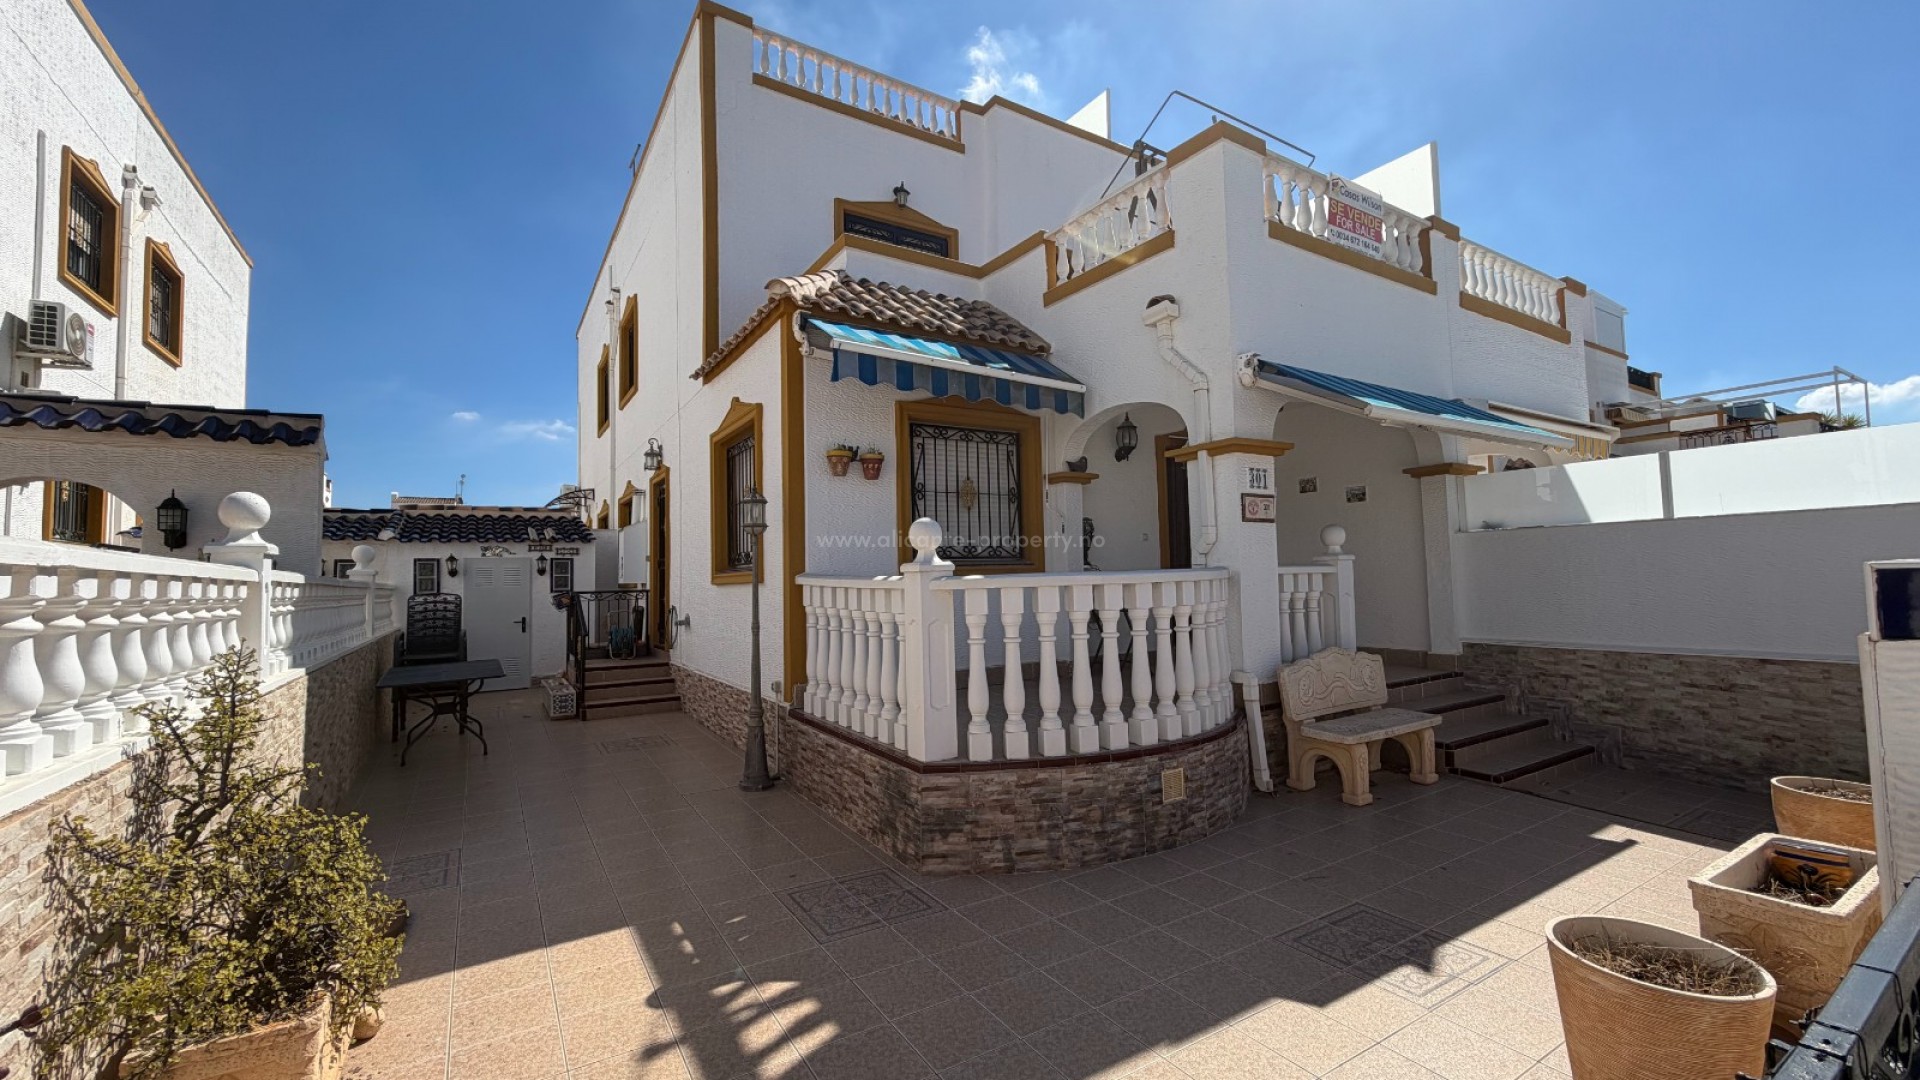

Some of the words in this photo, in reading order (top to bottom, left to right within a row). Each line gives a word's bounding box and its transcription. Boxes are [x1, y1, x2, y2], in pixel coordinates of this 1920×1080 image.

[1340, 185, 1359, 202] Casas
[1361, 194, 1382, 212] Wilson
[1330, 199, 1345, 216] SE
[1347, 206, 1381, 230] VENDE
[1336, 215, 1354, 232] FOR
[1355, 223, 1376, 239] SALE
[1249, 467, 1268, 490] 301
